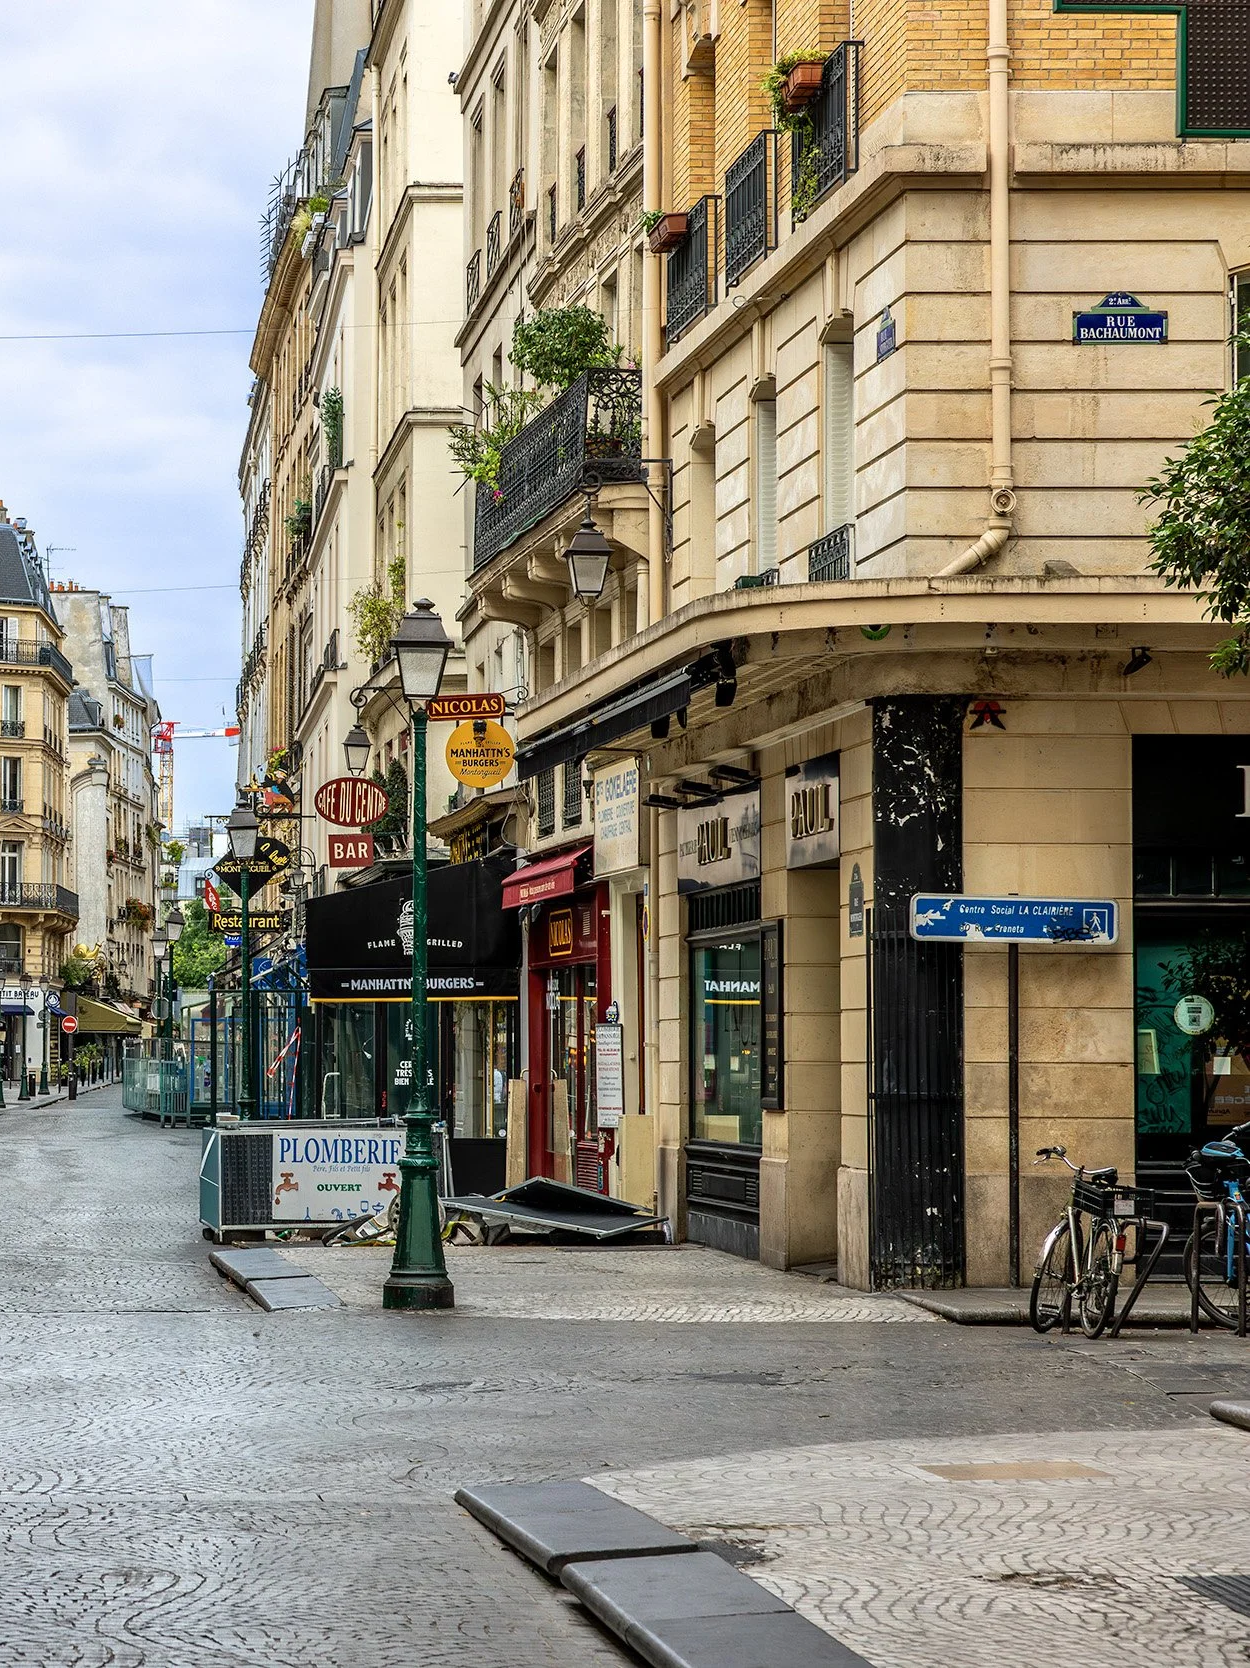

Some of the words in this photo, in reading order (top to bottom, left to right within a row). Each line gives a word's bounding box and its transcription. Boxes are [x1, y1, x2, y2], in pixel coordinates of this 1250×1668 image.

[1106, 316, 1135, 327] RUE
[1080, 327, 1161, 339] BACHAUMONT
[432, 698, 499, 714] NICOLAS
[450, 747, 510, 758] MANHATTN'S
[462, 759, 499, 767] BURGERS
[460, 767, 501, 779] Montorgueil
[339, 781, 353, 823] DU
[355, 781, 387, 824] CENTRE
[790, 783, 835, 841] PAUL
[697, 816, 732, 867] PAUL
[333, 842, 368, 859] BAR
[220, 865, 272, 873] MONTGUEIL
[959, 904, 985, 915] Centre
[991, 904, 1015, 915] Social
[1019, 905, 1030, 915] LA
[1032, 904, 1074, 916] CLAIRIÈRE
[367, 939, 396, 949] FLAME
[426, 938, 463, 949] GRILLED
[351, 977, 414, 990] MANHATTN'
[14, 990, 39, 998] BAEAU
[394, 1078, 410, 1086] BIEN
[279, 1137, 402, 1165] PLOMBERIE
[316, 1183, 362, 1192] OUVERT
